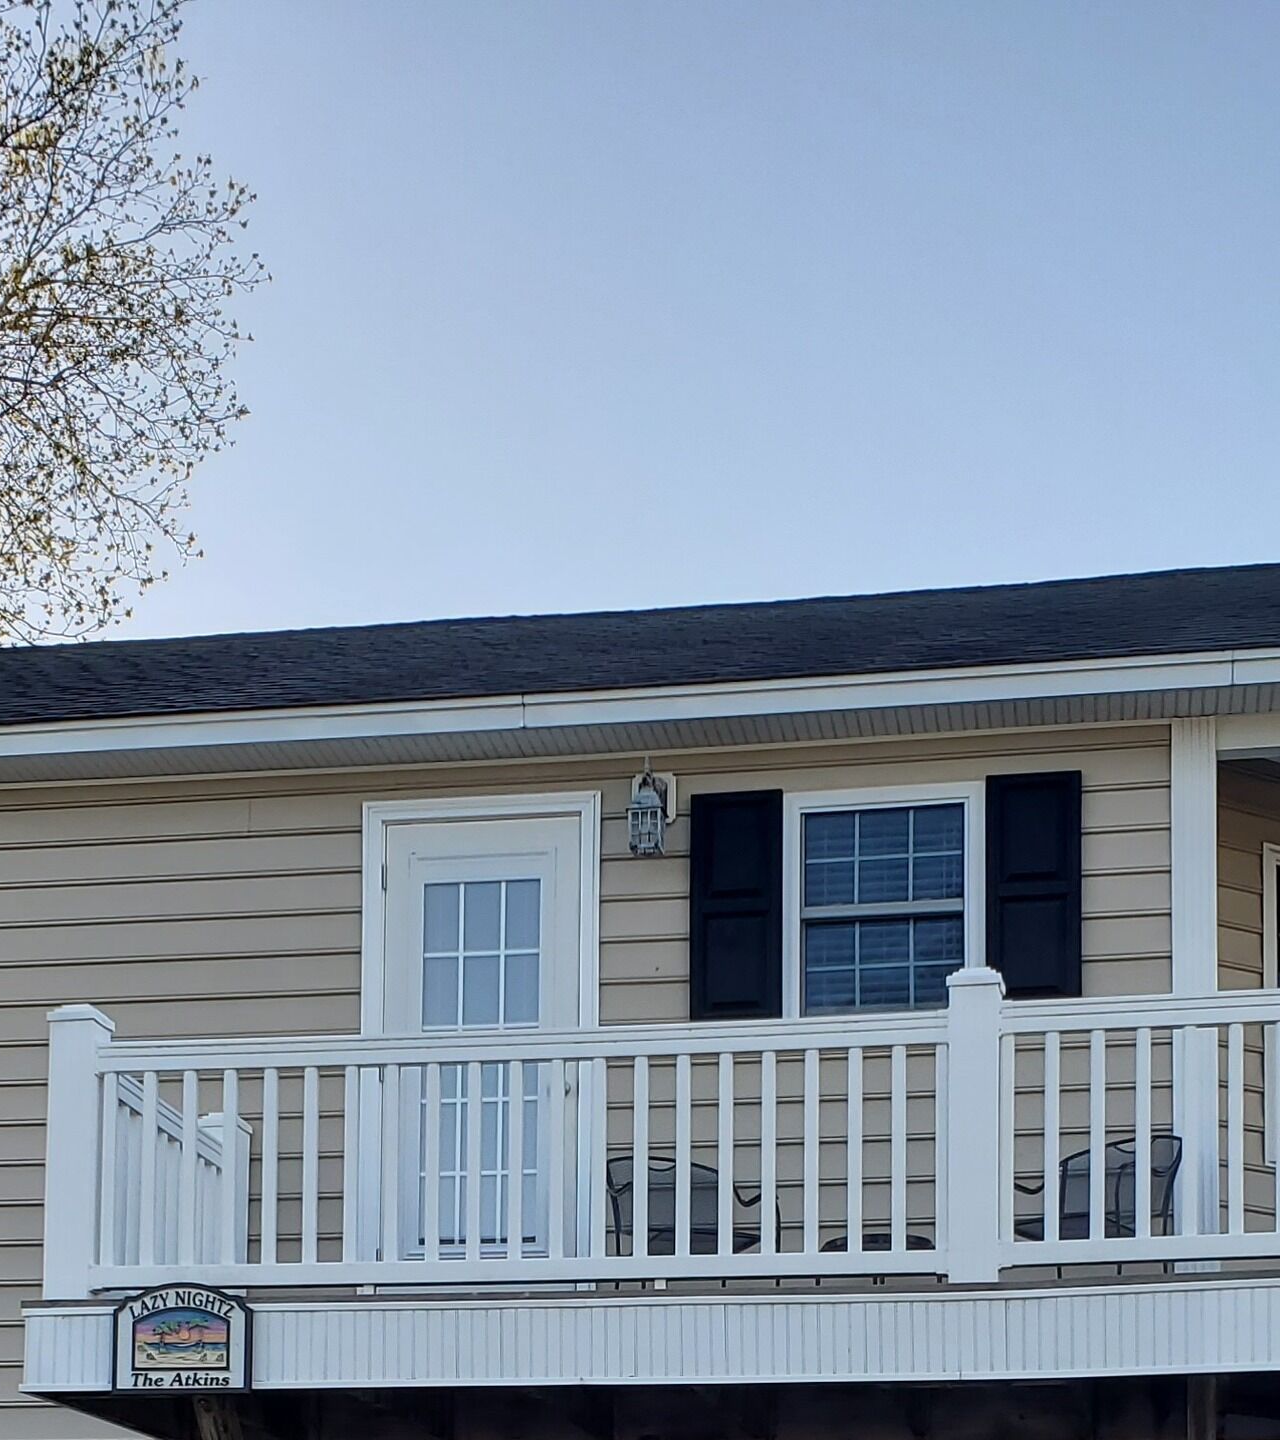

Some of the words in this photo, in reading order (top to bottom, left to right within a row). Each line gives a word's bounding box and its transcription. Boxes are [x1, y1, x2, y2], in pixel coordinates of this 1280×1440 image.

[129, 1291, 170, 1321] LAZY
[175, 1290, 236, 1319] NIGHTZ
[131, 1373, 164, 1387] The
[170, 1372, 230, 1387] Atkins
